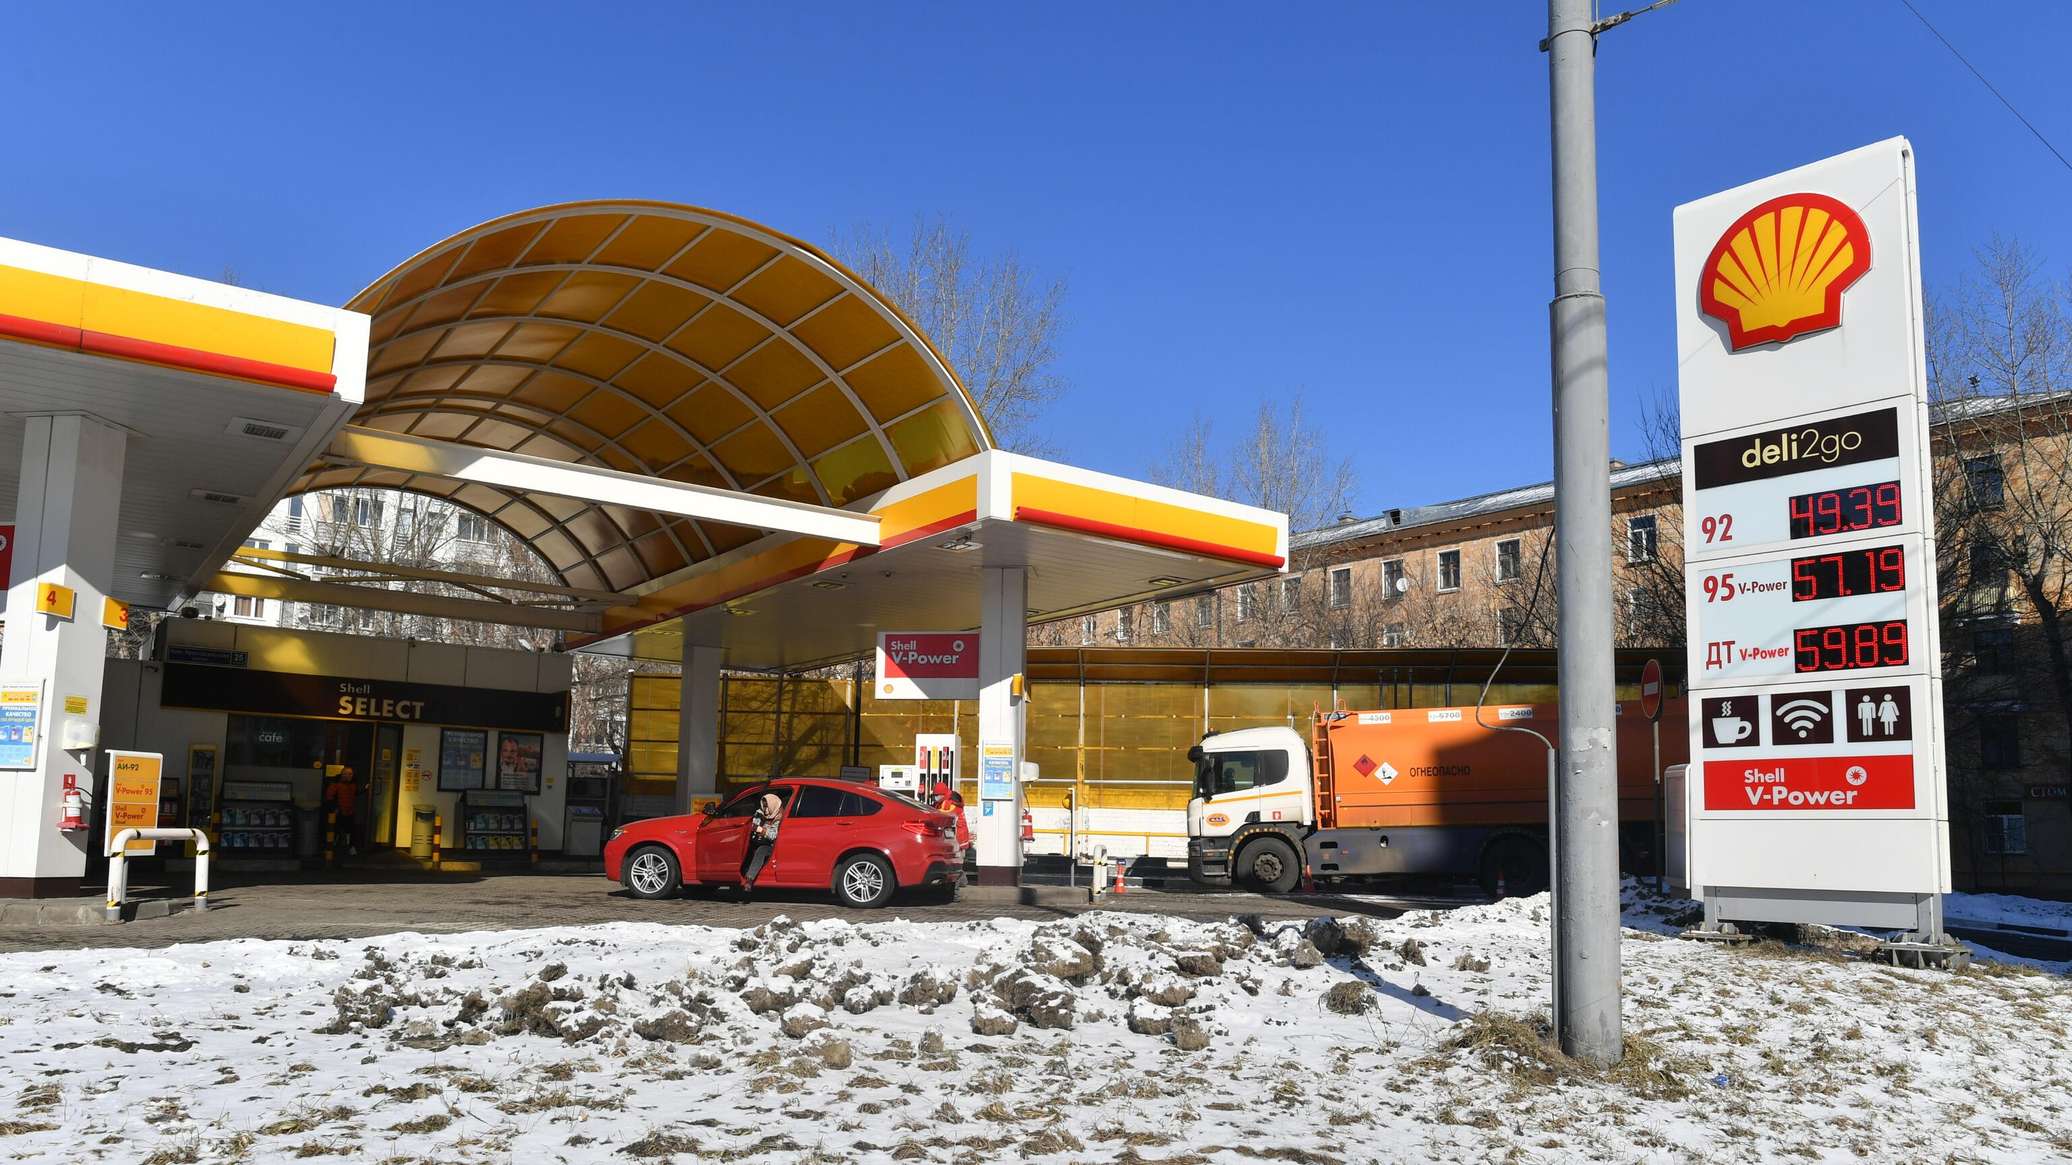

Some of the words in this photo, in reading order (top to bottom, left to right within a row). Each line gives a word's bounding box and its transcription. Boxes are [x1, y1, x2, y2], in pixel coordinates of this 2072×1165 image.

[1741, 428, 1862, 468] deli2go
[1701, 513, 1733, 544] 92
[1791, 482, 1901, 537] 49.39
[1703, 573, 1736, 603] 95
[1738, 580, 1788, 594] V-Power
[1792, 547, 1904, 602] 57.19
[46, 590, 57, 606] 4
[119, 607, 128, 622] 3
[891, 640, 916, 650] Shell
[1706, 640, 1736, 670] ДТ
[1739, 647, 1790, 661] V-Power
[1796, 622, 1908, 672] 59.89
[891, 651, 959, 664] V-Power
[339, 682, 370, 694] Shell
[338, 695, 424, 719] SELECT
[117, 763, 139, 771] АИ-92
[1409, 765, 1471, 778] ОГНЕОПАСНО
[1744, 767, 1785, 783] Shell
[116, 785, 143, 795] V-Power
[1744, 786, 1858, 806] V-Power
[115, 811, 144, 820] V-Power
